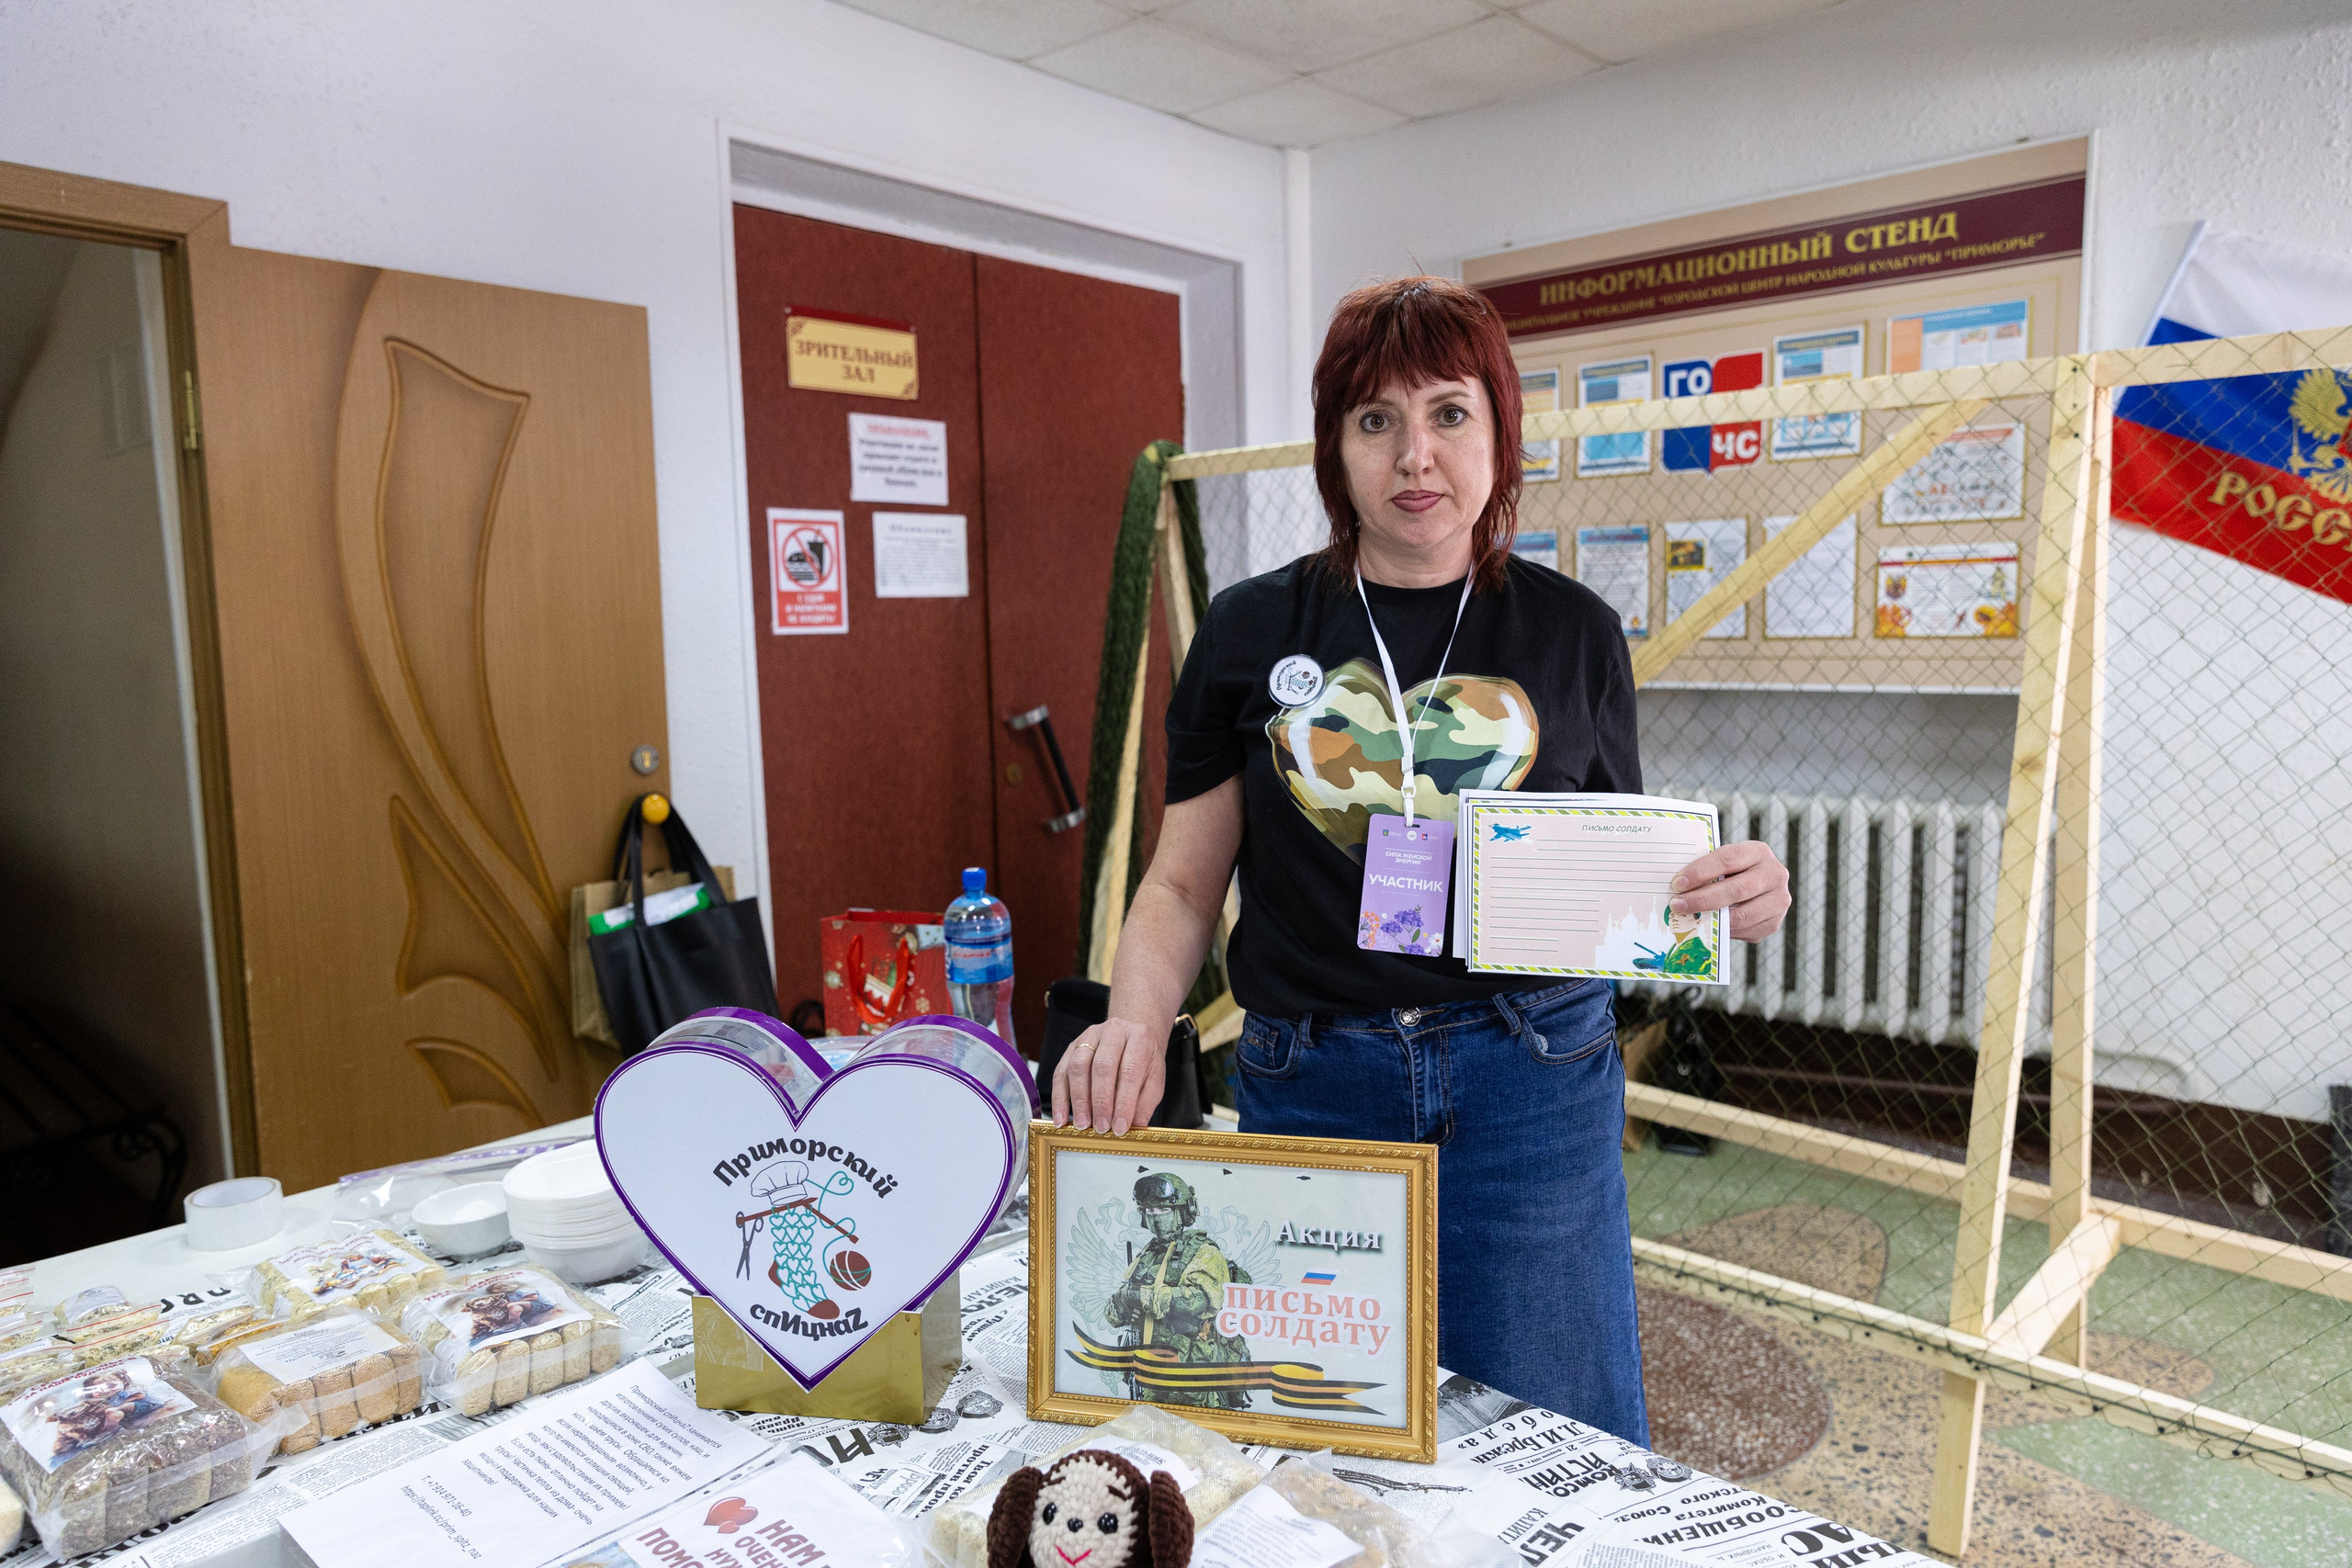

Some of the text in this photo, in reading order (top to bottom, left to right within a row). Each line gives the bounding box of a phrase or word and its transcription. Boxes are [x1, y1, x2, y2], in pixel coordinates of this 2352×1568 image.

[1539, 211, 1959, 306] ИНФОРМАЦИОННЫЙ СТЕНД
[1741, 276, 1781, 294] ЦЕНТР
[1785, 263, 1865, 288] НАРОДНОЙ
[1868, 253, 1942, 274] КУЛЬТУРЫ
[795, 340, 913, 369] ЗРИТЕЛЬНЫЙ
[842, 364, 876, 383] ЗАЛ
[1668, 367, 1712, 397] ГО
[1712, 429, 1759, 460] ЧС
[2207, 471, 2352, 553] РОСС
[1403, 852, 1432, 861] ЖЕНСКОЙ
[1368, 874, 1444, 893] УЧАСТНИК
[712, 1137, 899, 1199] Приморский
[1278, 1219, 1380, 1251] Акция
[600, 1401, 684, 1458] других вкусняшек для мужчин,
[616, 1393, 658, 1423] изготовлением
[655, 1422, 673, 1434] сухих
[671, 1433, 690, 1446] супов,
[689, 1445, 704, 1455] каш,
[630, 1385, 668, 1413] Приморский
[686, 1427, 722, 1449] занимается
[542, 1426, 635, 1495] кого-то имеются излишки овощей,
[557, 1418, 572, 1429] всем
[616, 1463, 648, 1487] возможно,
[587, 1406, 624, 1431] находящихся
[625, 1433, 640, 1445] зоне
[639, 1443, 654, 1455] СВО,
[652, 1453, 672, 1466] также
[670, 1465, 692, 1481] вяжем
[589, 1425, 606, 1437] шьем
[605, 1436, 623, 1450] трусы.
[624, 1450, 662, 1477] Обращаемся
[949, 1444, 989, 1482] против
[1565, 1444, 1577, 1452] 21
[494, 1446, 516, 1460] трусы!
[513, 1458, 537, 1478] Частичка
[535, 1476, 552, 1491] тепла
[574, 1510, 593, 1525] очень
[498, 1468, 530, 1493] поддержка
[525, 1493, 541, 1503] для
[537, 1502, 559, 1517] наших
[511, 1438, 526, 1450] Если
[523, 1449, 536, 1458] есть
[550, 1470, 575, 1489] отлично
[572, 1488, 596, 1505] пойдет
[550, 1451, 595, 1485] удовольствием
[600, 1489, 631, 1510] примем!
[962, 1460, 994, 1485] Твоя
[432, 1485, 447, 1495] 914
[441, 1494, 471, 1517] 971-16-40
[1674, 1495, 1767, 1523] Комитета
[754, 1519, 826, 1567] НАМ
[1727, 1543, 1773, 1559] НАРОДНЫХ
